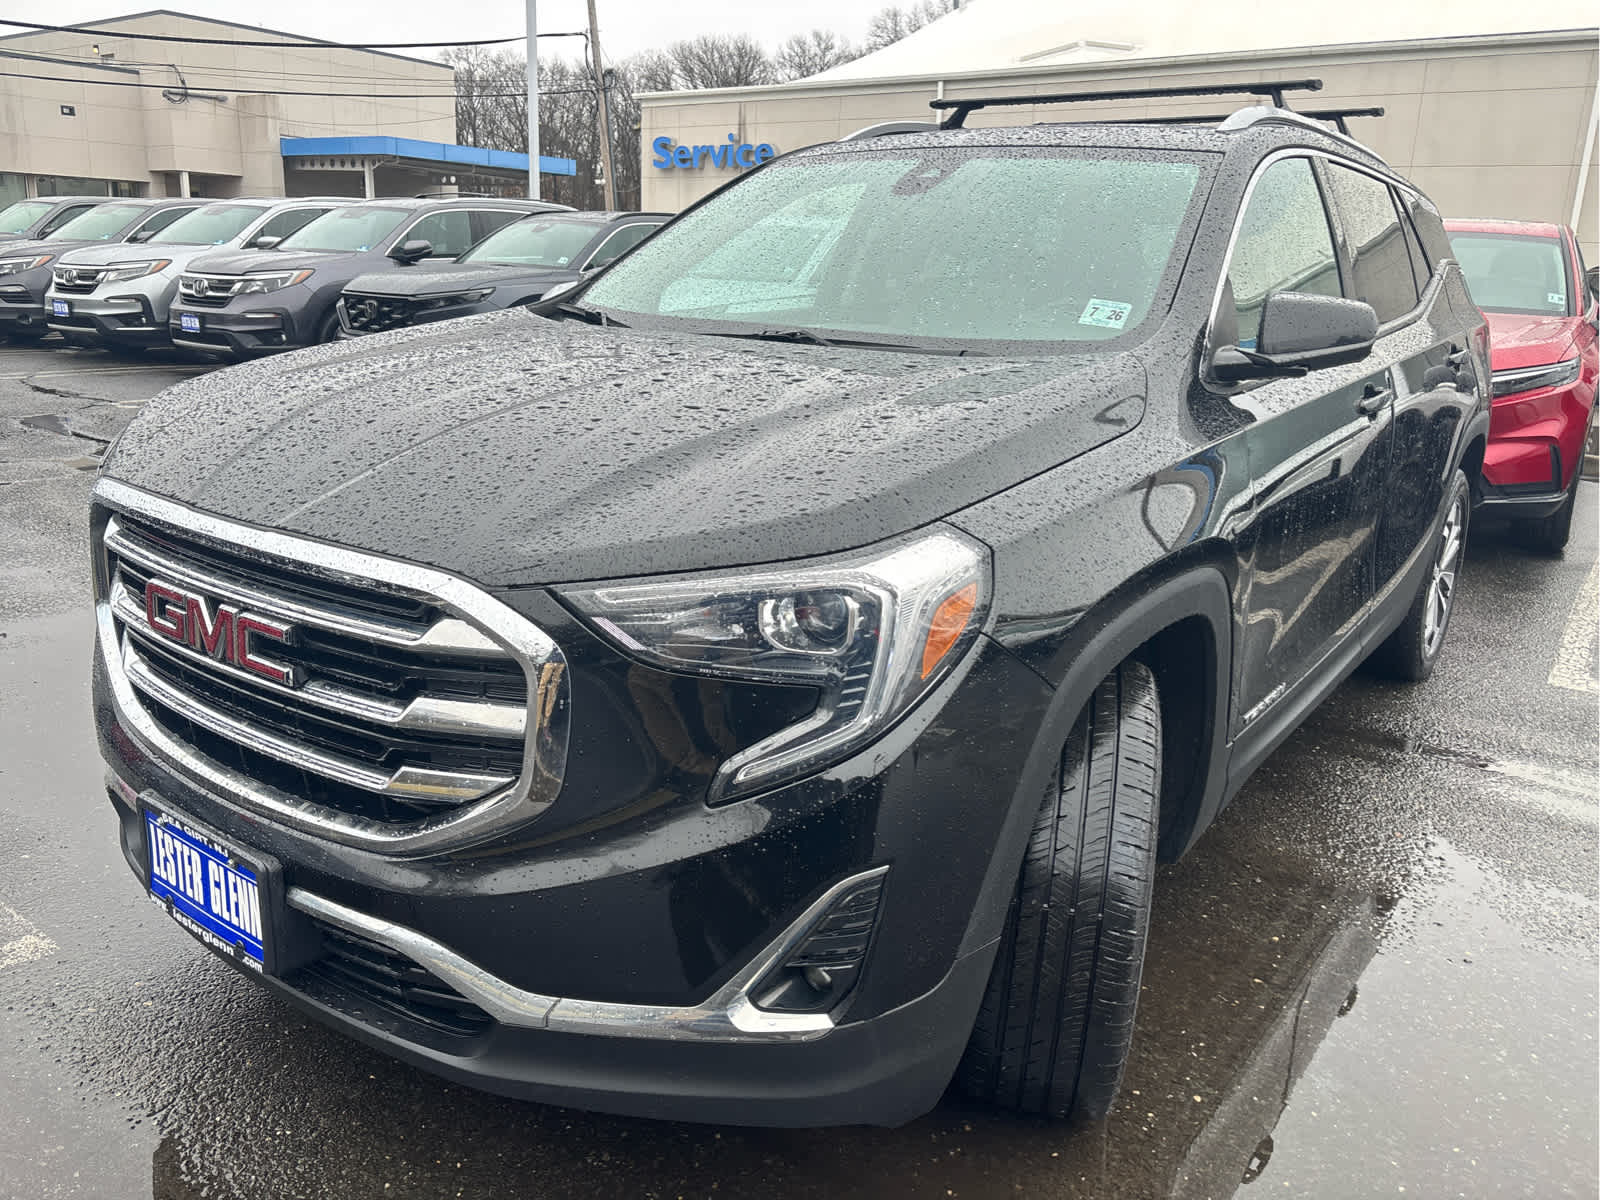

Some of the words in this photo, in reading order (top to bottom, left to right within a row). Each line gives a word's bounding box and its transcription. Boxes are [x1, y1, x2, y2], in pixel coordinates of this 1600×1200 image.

[652, 132, 775, 168] Service
[1088, 306, 1100, 317] 7
[1106, 309, 1124, 321] 26
[145, 578, 293, 687] GMC
[149, 823, 204, 905] LESTER
[208, 859, 263, 942] GLENN
